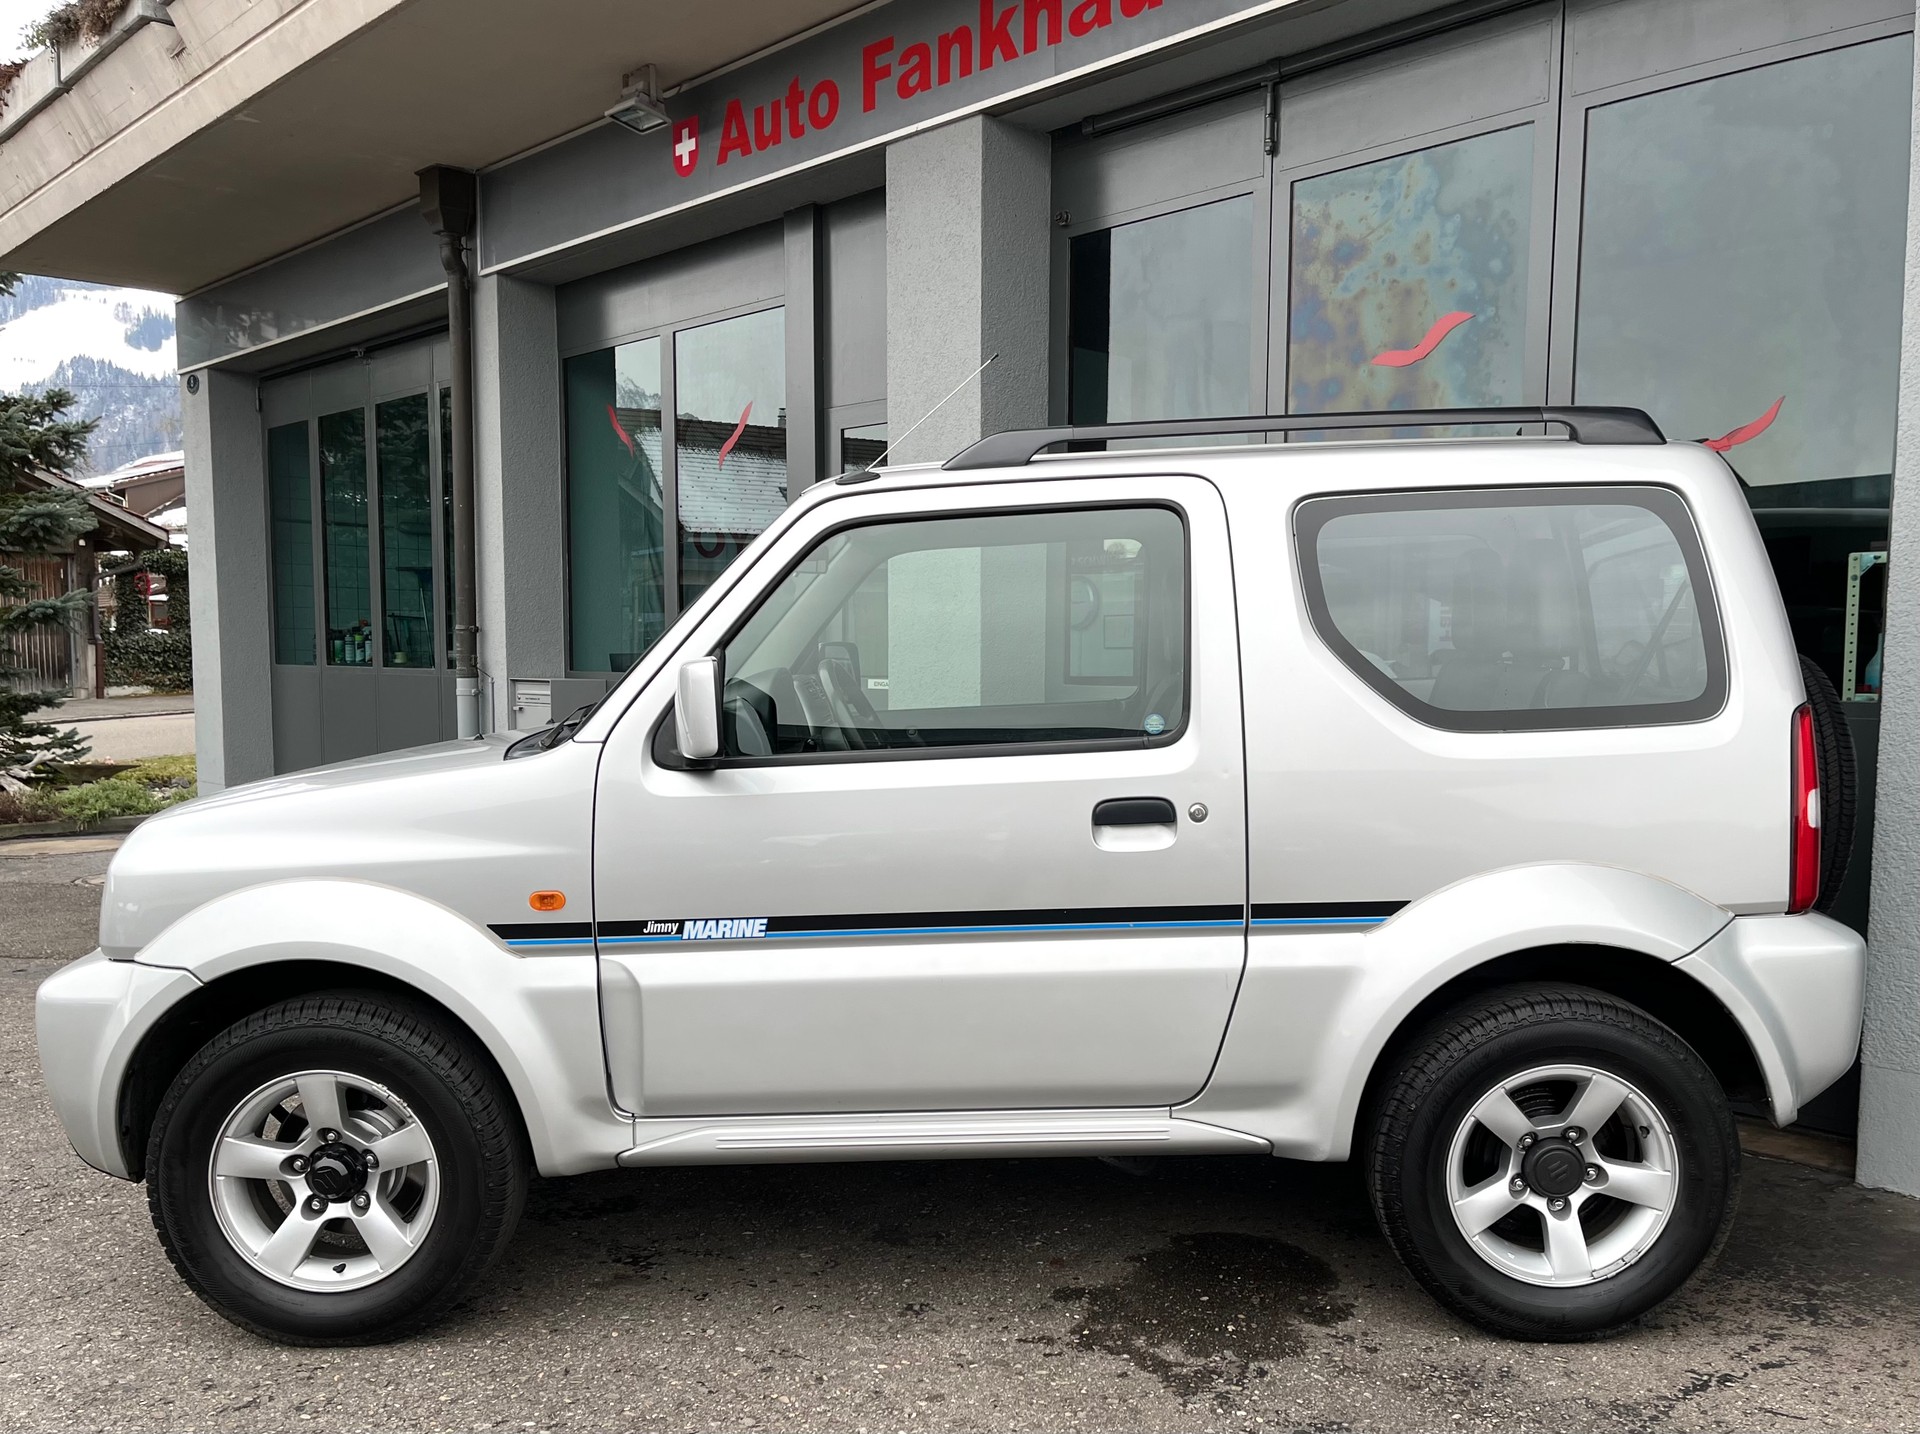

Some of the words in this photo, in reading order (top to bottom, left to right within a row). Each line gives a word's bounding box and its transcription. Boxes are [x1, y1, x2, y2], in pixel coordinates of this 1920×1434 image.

[717, 76, 840, 166] Auto
[643, 921, 679, 935] Jimny
[682, 918, 768, 940] MARINE
